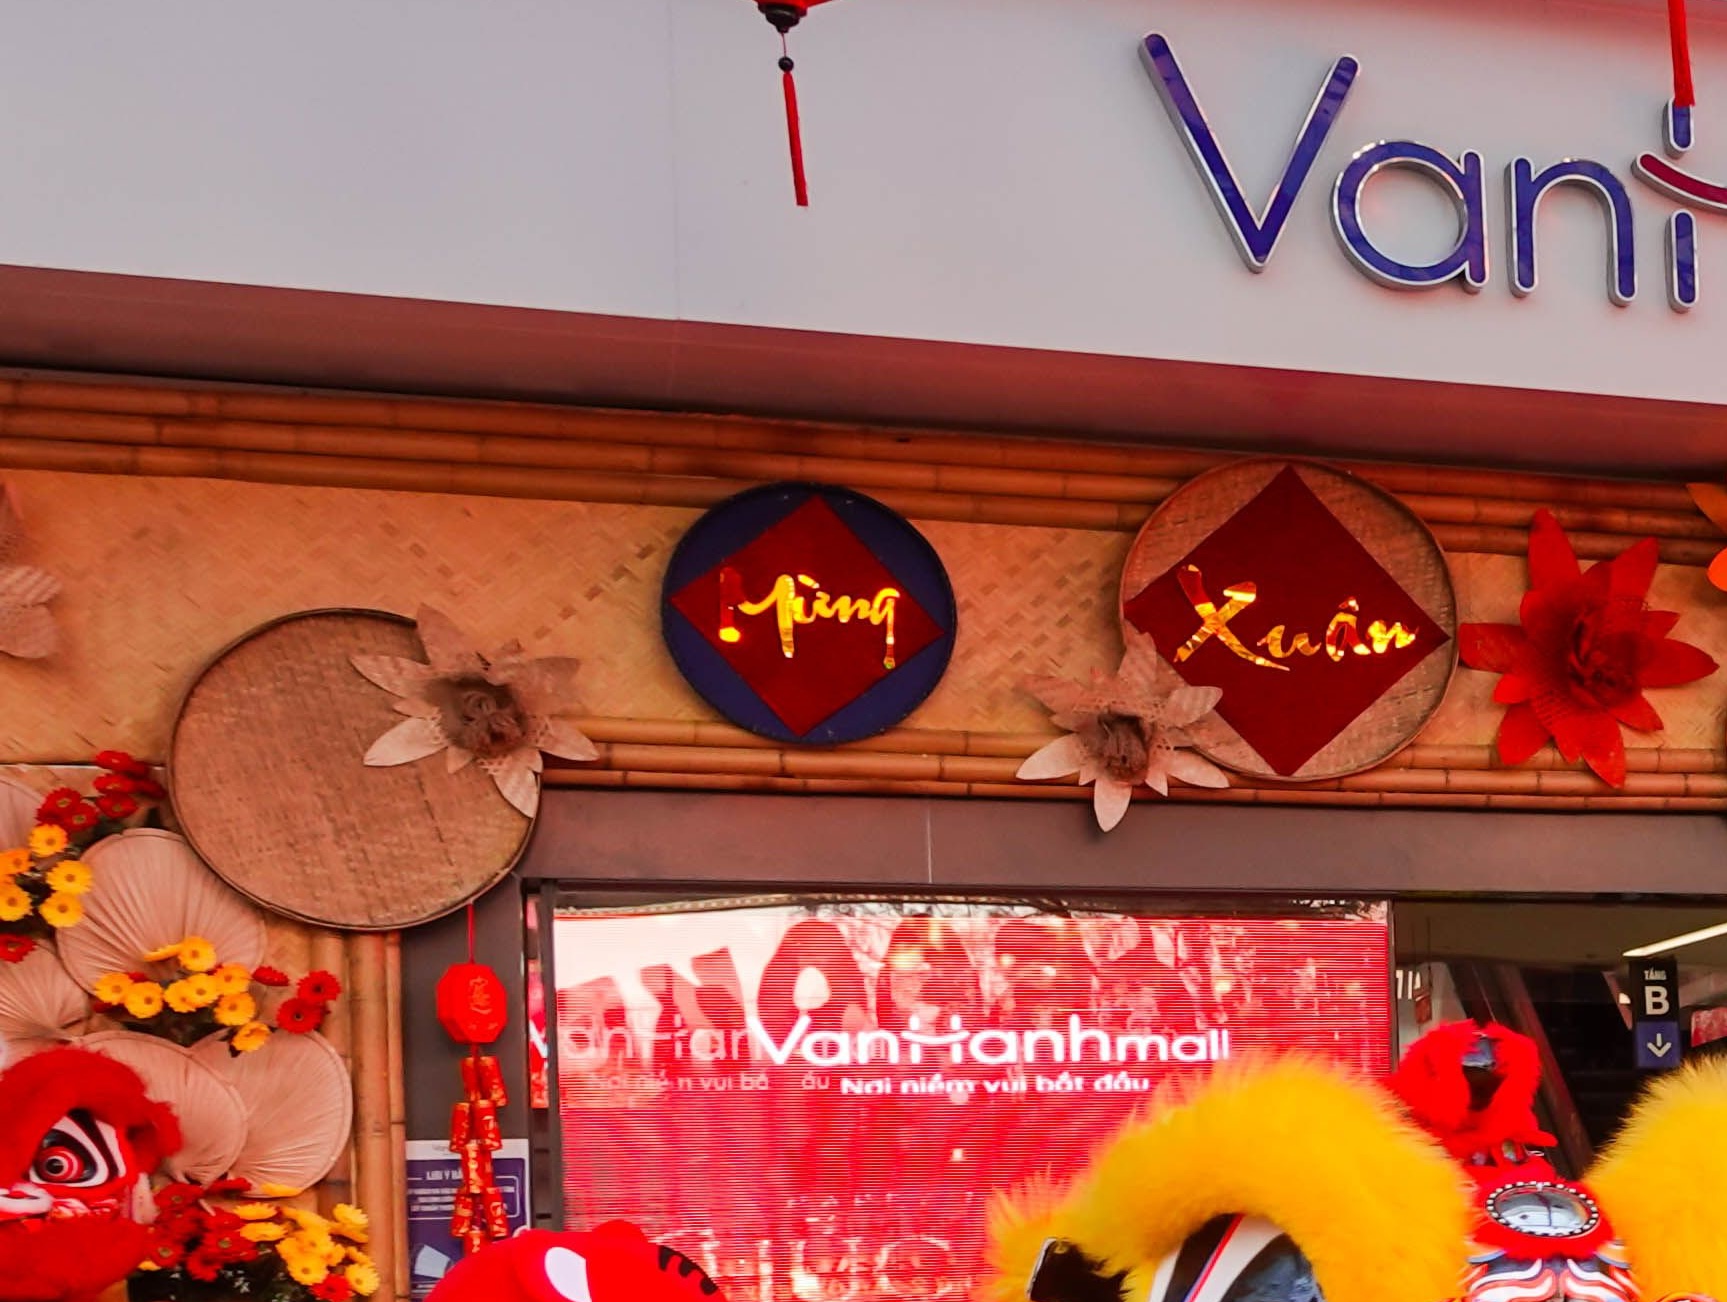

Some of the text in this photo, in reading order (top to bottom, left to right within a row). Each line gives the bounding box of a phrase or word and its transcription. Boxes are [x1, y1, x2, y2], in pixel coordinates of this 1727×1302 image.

[1174, 563, 1421, 673] Xuân
[1644, 985, 1670, 1015] B
[982, 1075, 1027, 1093] vui
